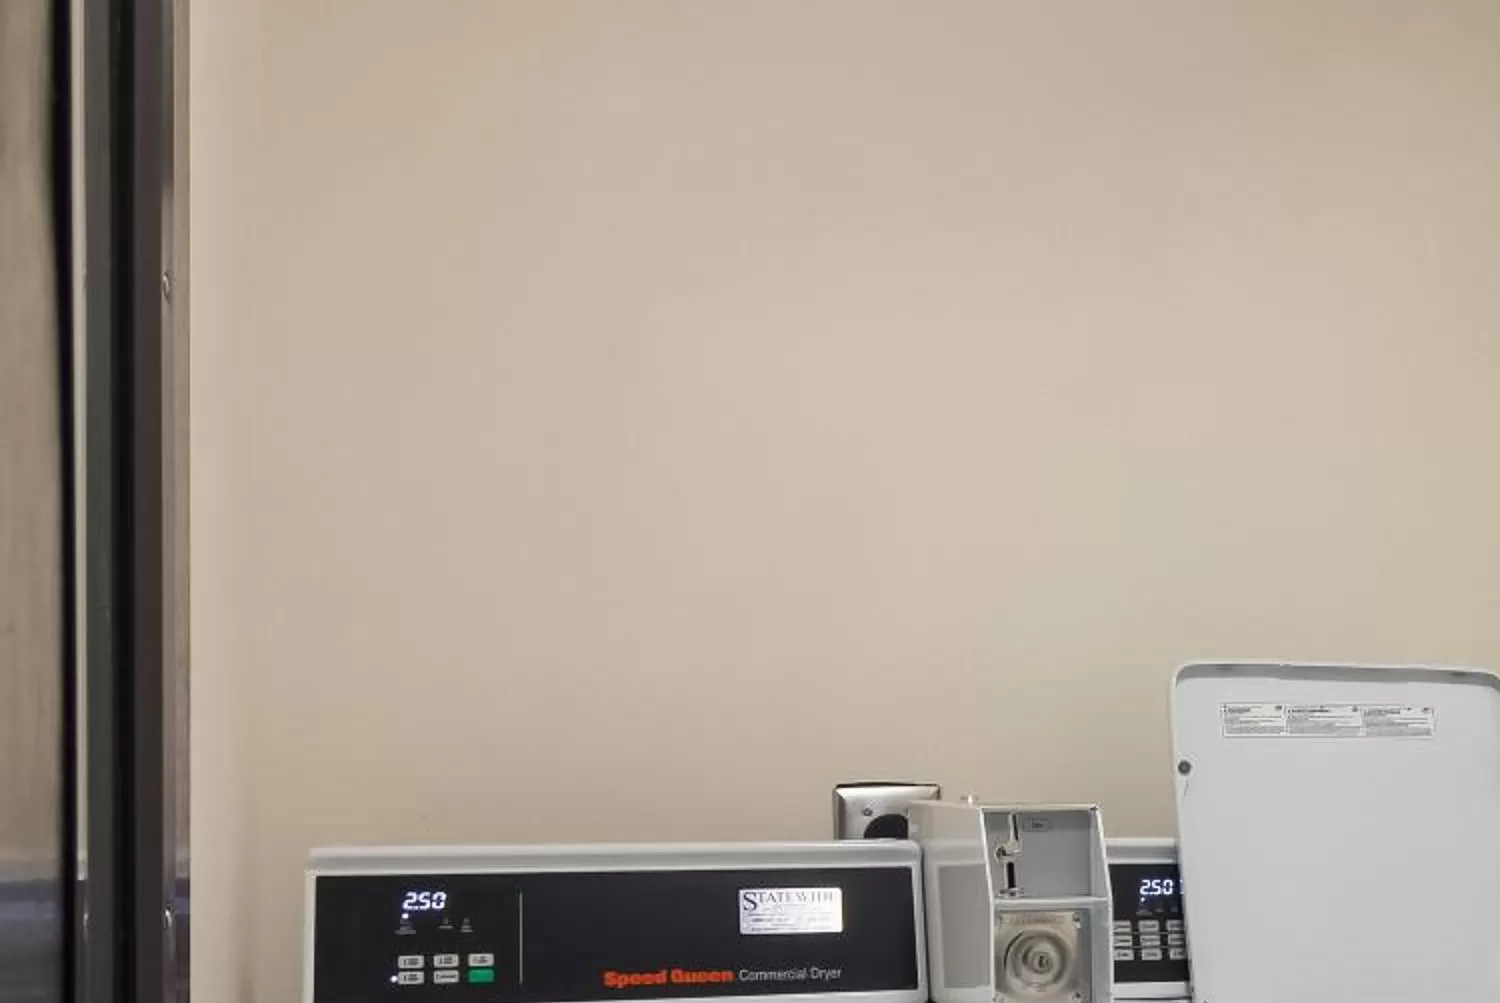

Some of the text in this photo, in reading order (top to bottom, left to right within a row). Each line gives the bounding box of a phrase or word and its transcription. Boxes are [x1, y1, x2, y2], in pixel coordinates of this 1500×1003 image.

[604, 966, 841, 988] Speed Queen Commercial Dryer
